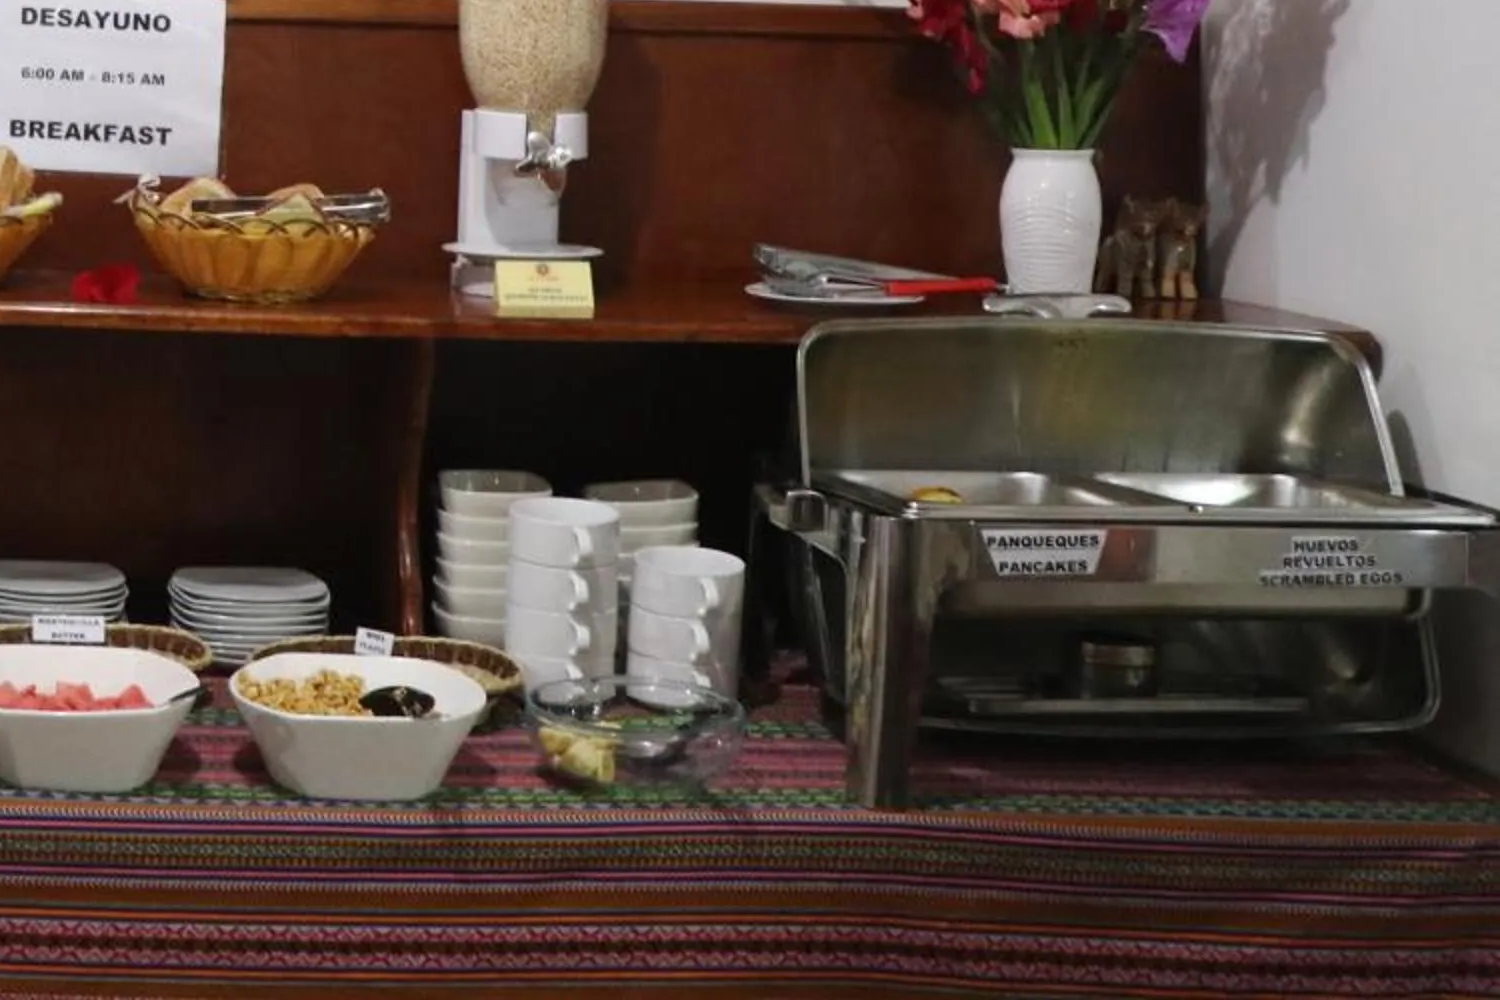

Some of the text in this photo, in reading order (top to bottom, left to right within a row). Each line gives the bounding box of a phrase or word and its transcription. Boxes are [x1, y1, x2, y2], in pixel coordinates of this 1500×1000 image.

[21, 6, 172, 33] DESAYUNO
[21, 66, 55, 80] 6:00
[59, 68, 85, 82] AM
[101, 71, 135, 85] 8:15
[139, 73, 165, 87] AM
[8, 118, 173, 147] BREAKFAST
[986, 534, 1100, 550] PANQUEQUES
[1293, 538, 1360, 553] HUEVOS
[999, 559, 1089, 574] PANCAKES
[1282, 555, 1377, 569] REVUELTOS
[1259, 570, 1404, 588] SCRAMBLED EGGS
